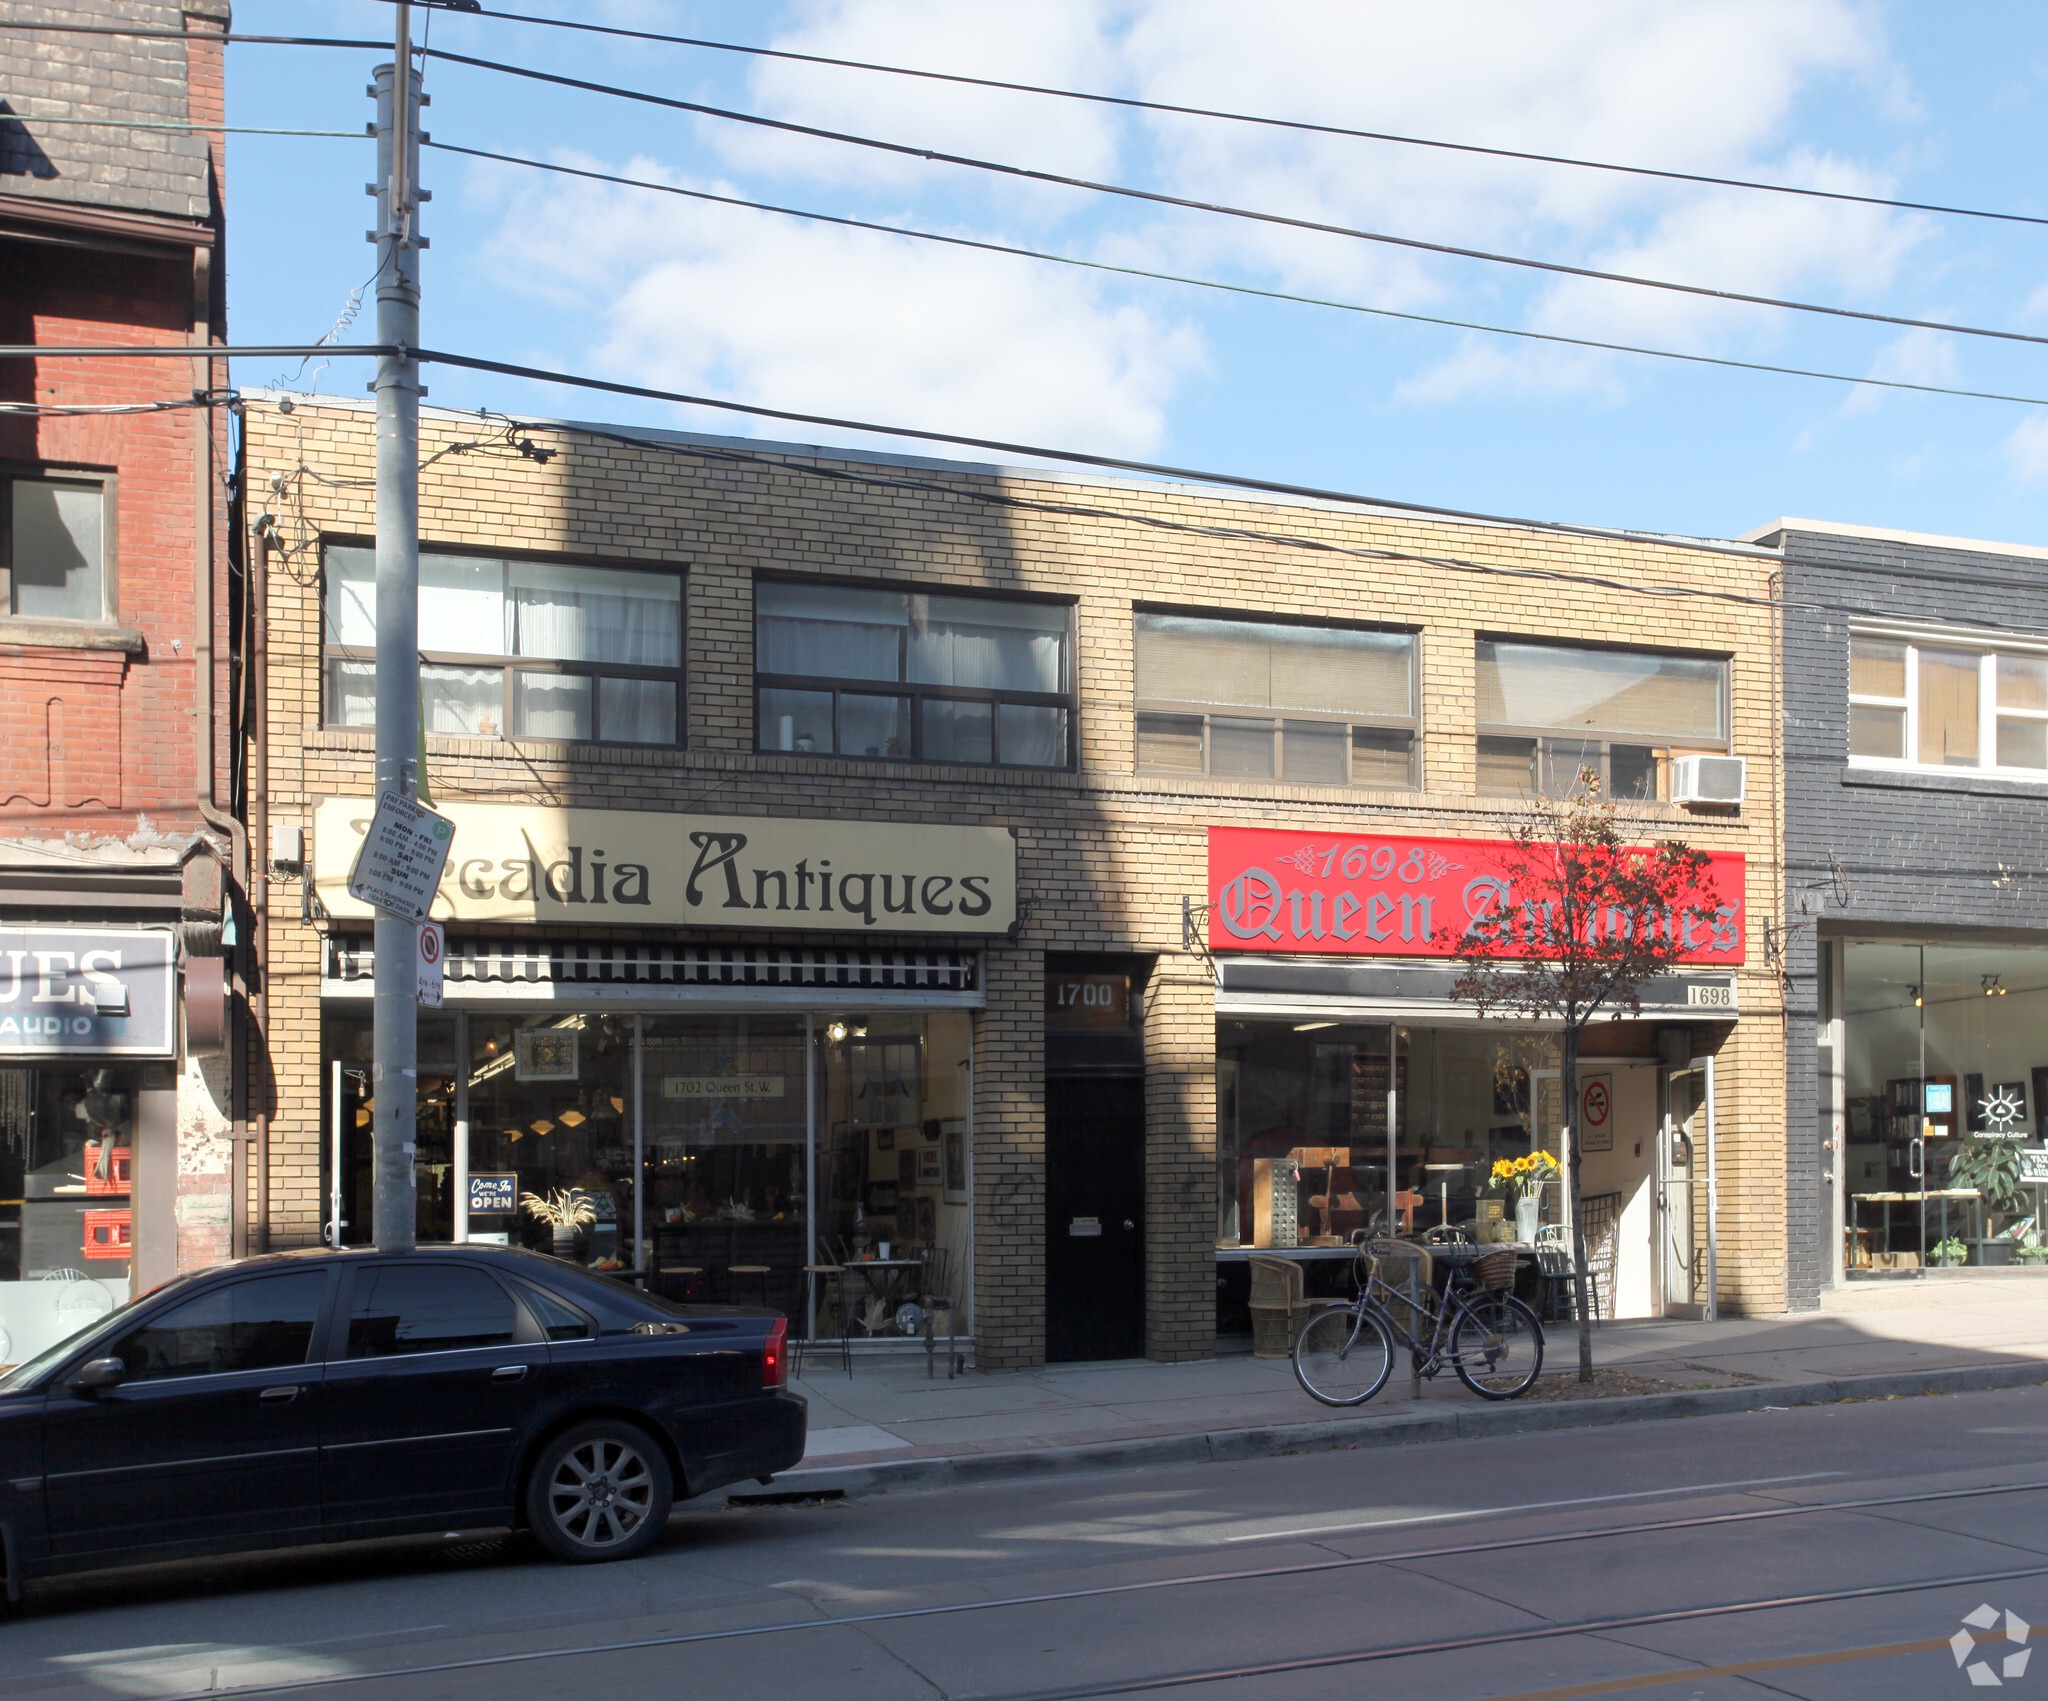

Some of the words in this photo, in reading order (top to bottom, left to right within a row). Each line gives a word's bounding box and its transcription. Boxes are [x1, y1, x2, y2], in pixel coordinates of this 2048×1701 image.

[383, 803, 416, 822] ENFORCED
[386, 794, 398, 804] PAY
[400, 800, 426, 818] PARKING
[382, 826, 397, 836] 8:00
[397, 832, 409, 842] AM
[414, 840, 426, 851] 4:00
[428, 847, 438, 856] PM
[394, 822, 413, 835] MON
[419, 834, 433, 845] FRI
[380, 836, 394, 846] 6:00
[395, 842, 406, 851] PM
[411, 850, 424, 859] 9:00
[424, 856, 435, 864] PM
[397, 852, 414, 863] SAT
[373, 851, 388, 861] 8:00
[389, 858, 400, 867] AM
[406, 865, 419, 874] 9:00
[420, 872, 430, 880] PM
[391, 868, 409, 880] SUN
[1318, 843, 1425, 884] 1698
[369, 868, 382, 877] 1:00
[382, 873, 394, 883] PM
[400, 880, 413, 890] 9:00
[414, 886, 424, 896] PM
[686, 831, 992, 925] Antiques
[1219, 866, 1435, 943] Queen
[1058, 984, 1112, 1006] 1700
[1691, 988, 1730, 1005] 1698
[0, 1016, 92, 1035] AUDIO
[675, 1082, 701, 1093] 1702
[706, 1082, 740, 1093] Queen
[744, 1081, 757, 1092] St.
[2030, 1155, 2048, 1164] TAX
[472, 1178, 498, 1194] Come
[498, 1180, 512, 1192] In
[472, 1196, 512, 1208] OPEN
